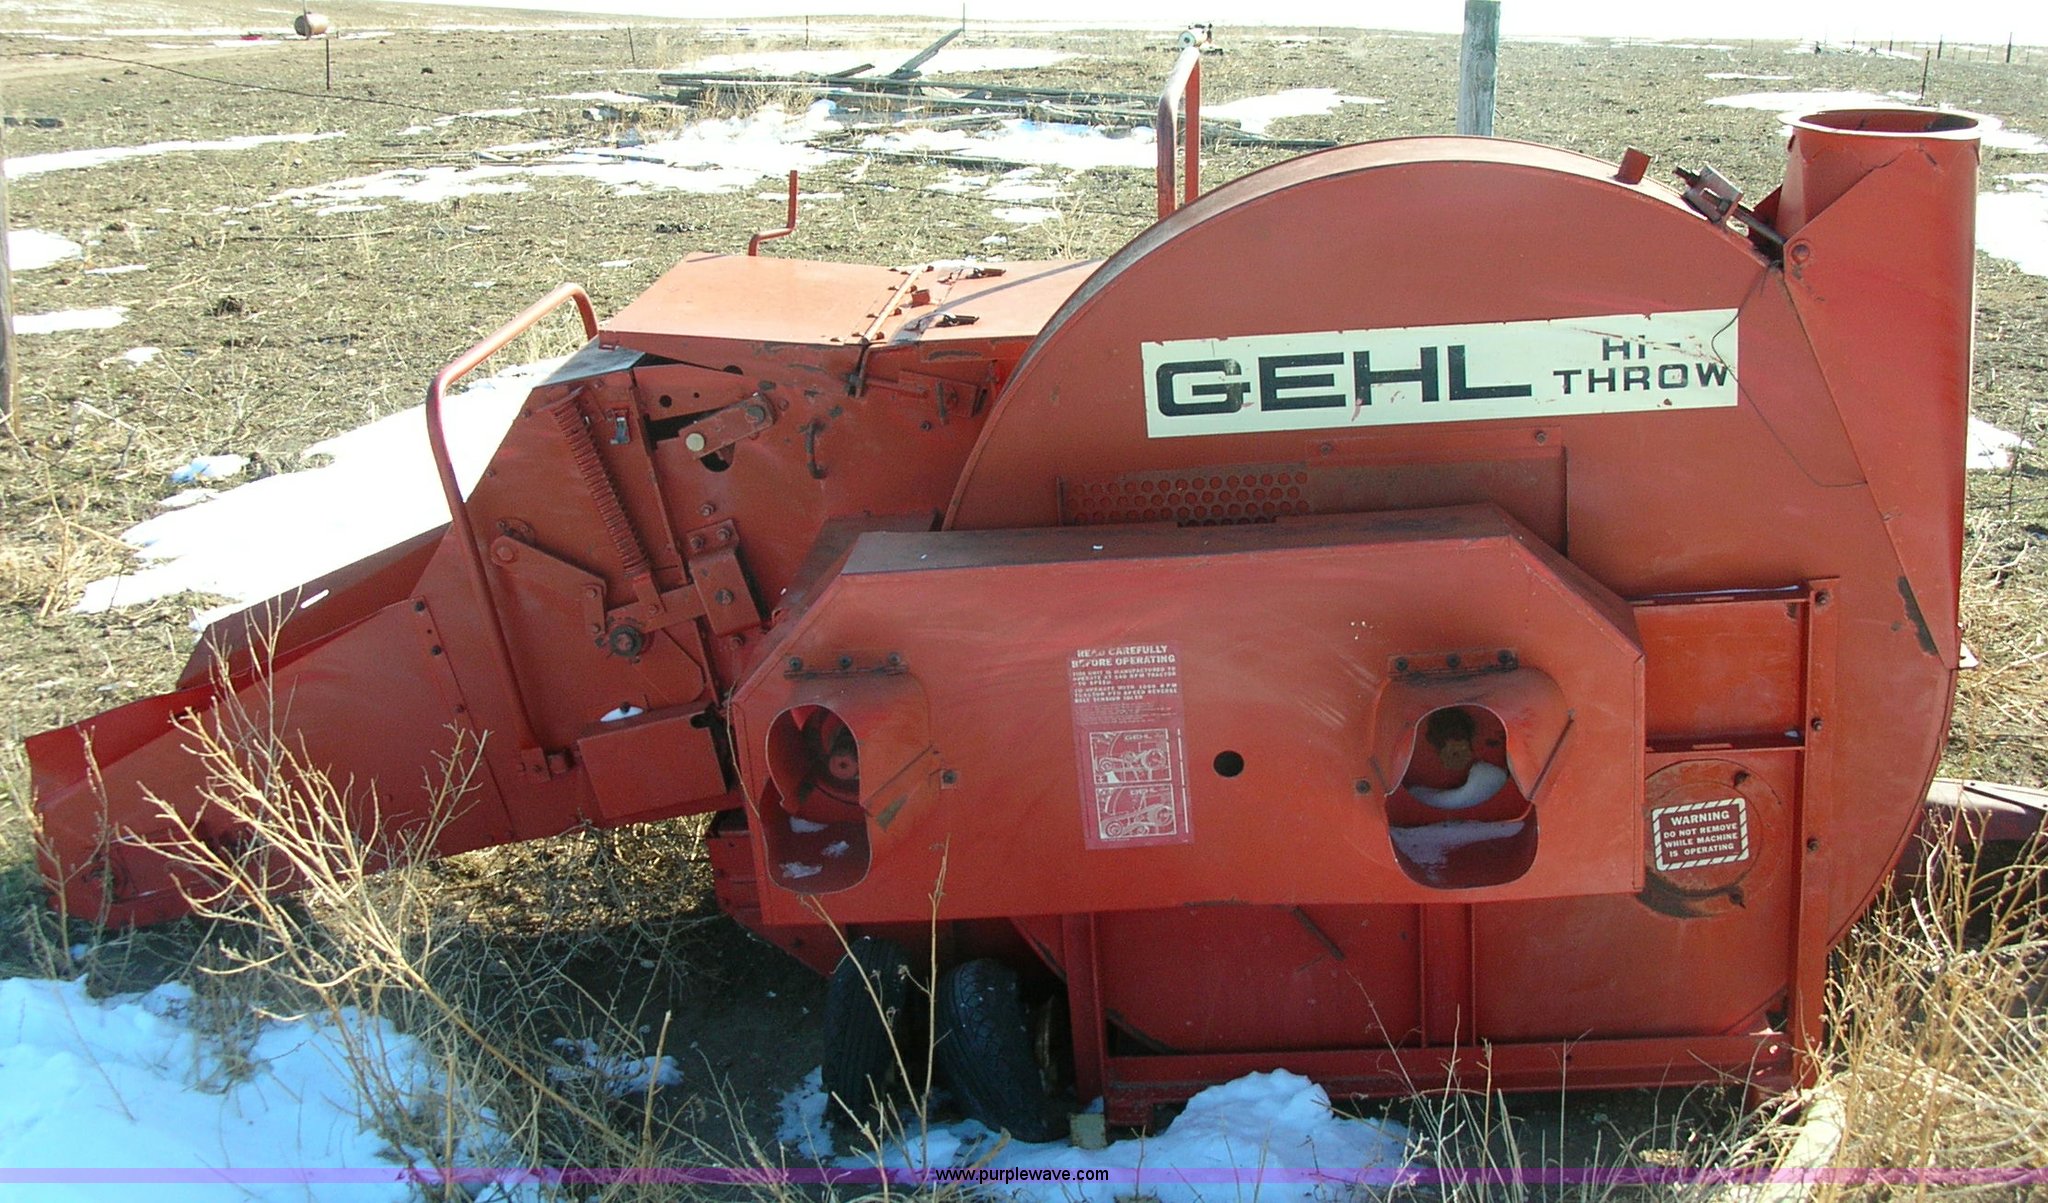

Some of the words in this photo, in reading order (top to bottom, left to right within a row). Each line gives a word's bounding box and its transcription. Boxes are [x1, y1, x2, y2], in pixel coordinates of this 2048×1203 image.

[1156, 344, 1532, 417] GEHL
[1553, 362, 1730, 395] THROW
[1108, 645, 1168, 656] CAREFULLY
[1071, 658, 1113, 668] BEFORE
[1115, 654, 1176, 666] OPERATING
[1113, 667, 1165, 675] MANUFACTURED
[1671, 810, 1730, 826] WARNING
[1664, 831, 1676, 839] DO
[1679, 828, 1697, 837] NOT
[1700, 823, 1738, 834] REMOVE
[1664, 838, 1693, 848] WHILE
[1696, 833, 1738, 844] MACHINE
[1669, 850, 1678, 858] IS
[1684, 843, 1734, 856] OPERATING
